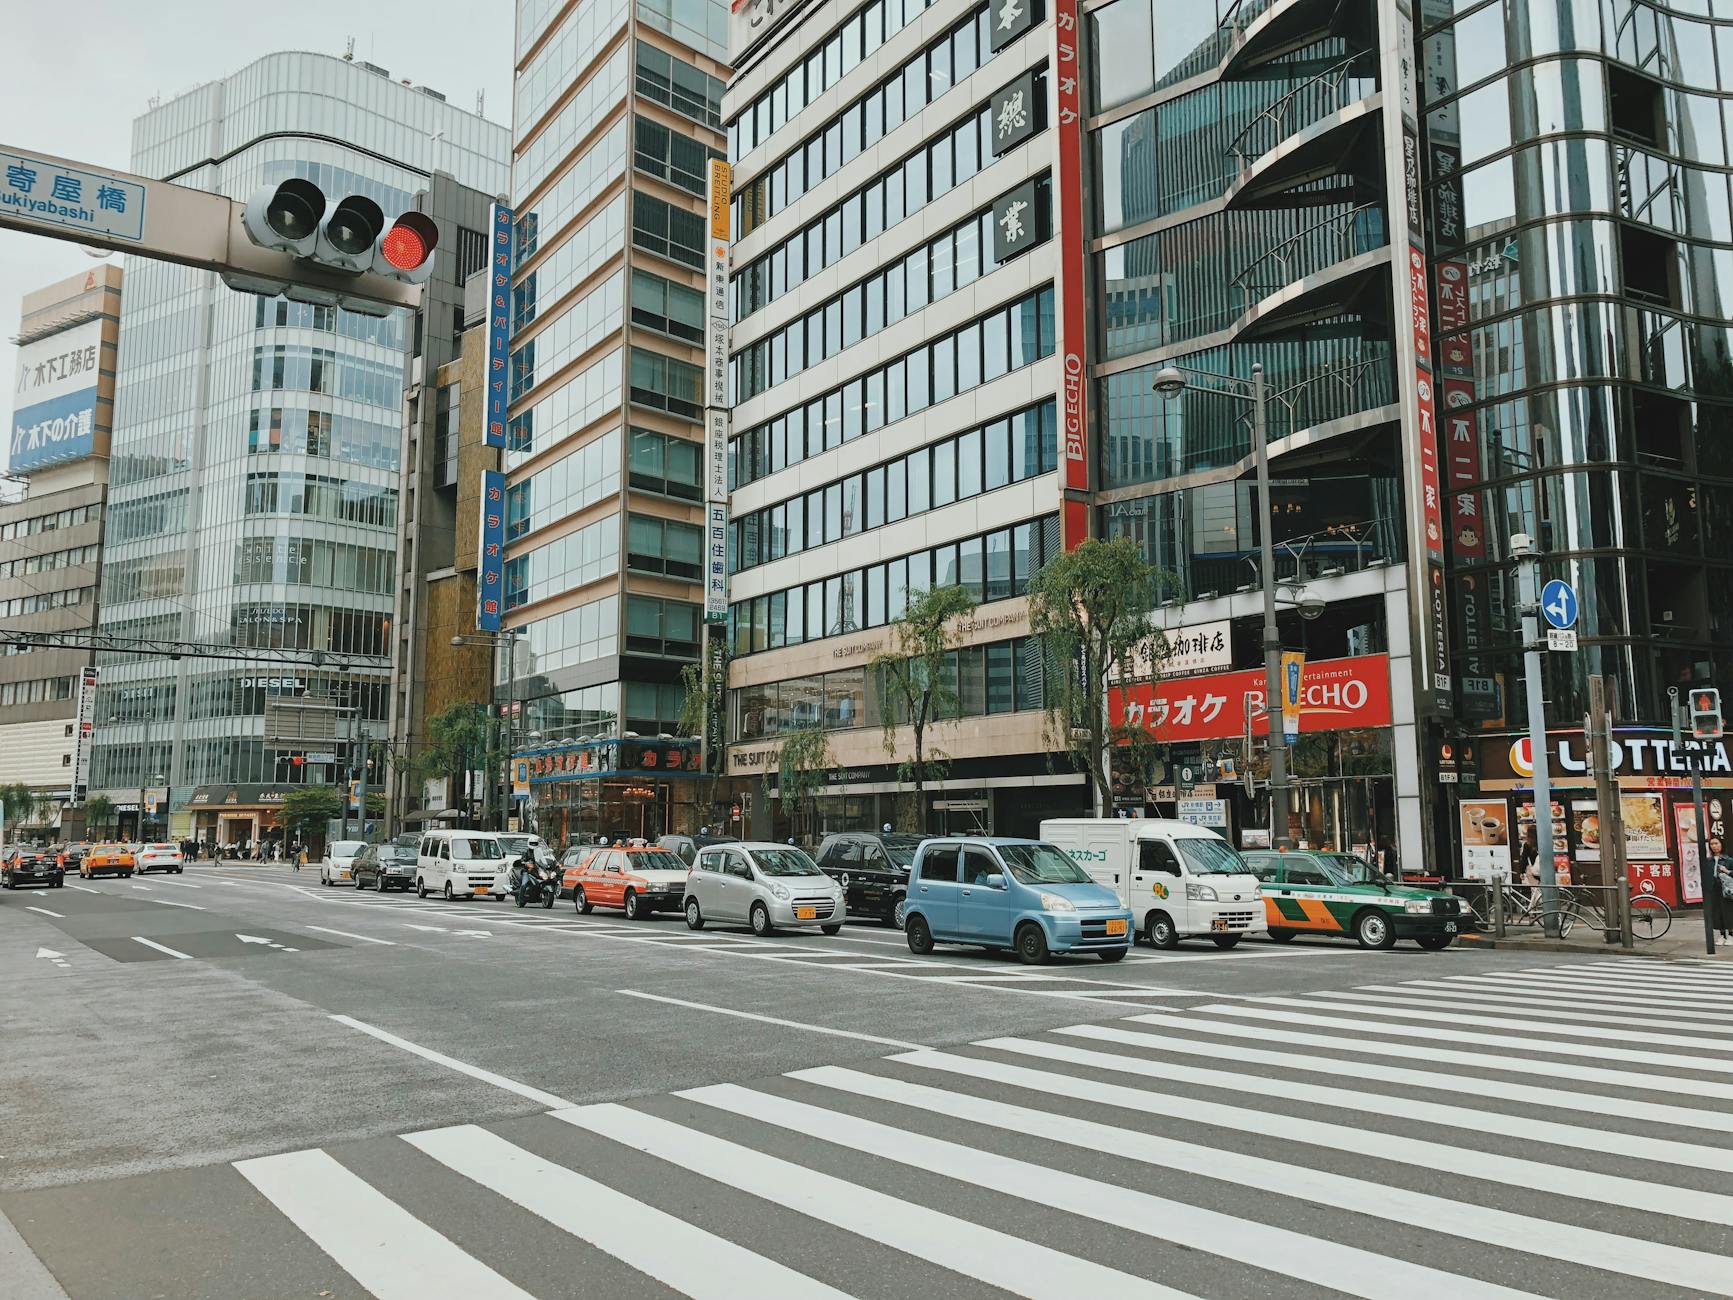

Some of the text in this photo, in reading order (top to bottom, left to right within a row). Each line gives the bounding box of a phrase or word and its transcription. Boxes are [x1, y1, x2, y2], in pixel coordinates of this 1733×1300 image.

[1058, 12, 1077, 125] カラオケ
[0, 190, 94, 222] ukiyabashi
[6, 165, 127, 213] 寄屋橋
[713, 164, 721, 221] BREITLING
[1000, 200, 1027, 243] 業
[715, 261, 725, 310] 新東通信
[34, 345, 96, 387] 木下工務店
[1065, 353, 1084, 461] BIG ECHO
[27, 408, 92, 450] 木下の介護
[1420, 409, 1436, 509] 不二家
[485, 487, 500, 614] カラオケ館
[712, 509, 725, 592] 五百住歯科
[959, 620, 972, 632] THE
[974, 617, 989, 630] SUIT
[1433, 589, 1445, 670] LOTTERIA
[713, 649, 722, 669] THE
[1304, 669, 1353, 681] ertainment
[241, 678, 304, 688] DIESEL
[1436, 675, 1447, 687] B1F
[1125, 694, 1227, 728] カラオケ
[733, 754, 748, 767] THE
[748, 752, 765, 766] SUIT
